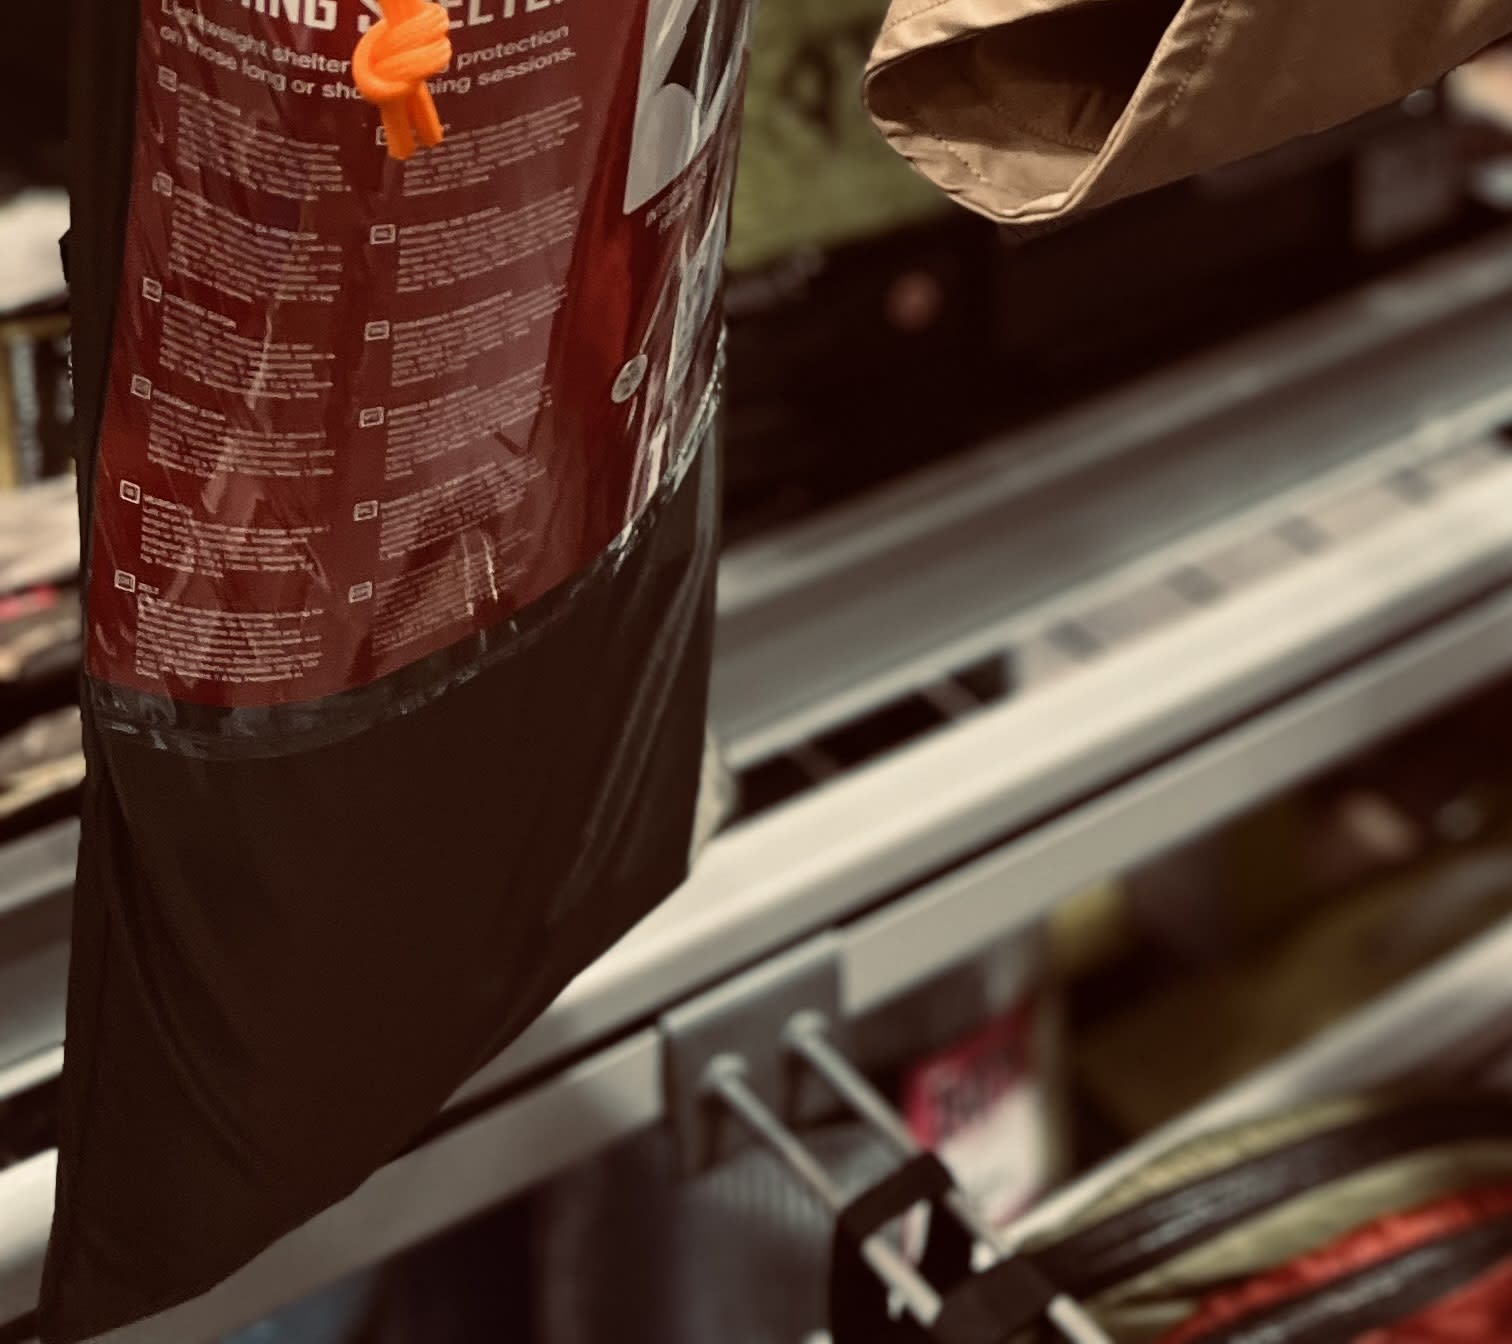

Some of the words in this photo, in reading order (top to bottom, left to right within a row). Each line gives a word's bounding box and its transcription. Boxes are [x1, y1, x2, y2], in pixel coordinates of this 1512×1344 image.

[242, 58, 287, 92] long
[291, 78, 317, 95] or
[477, 45, 577, 87] sessions.
[271, 45, 352, 74] shelter
[456, 24, 570, 69] protection
